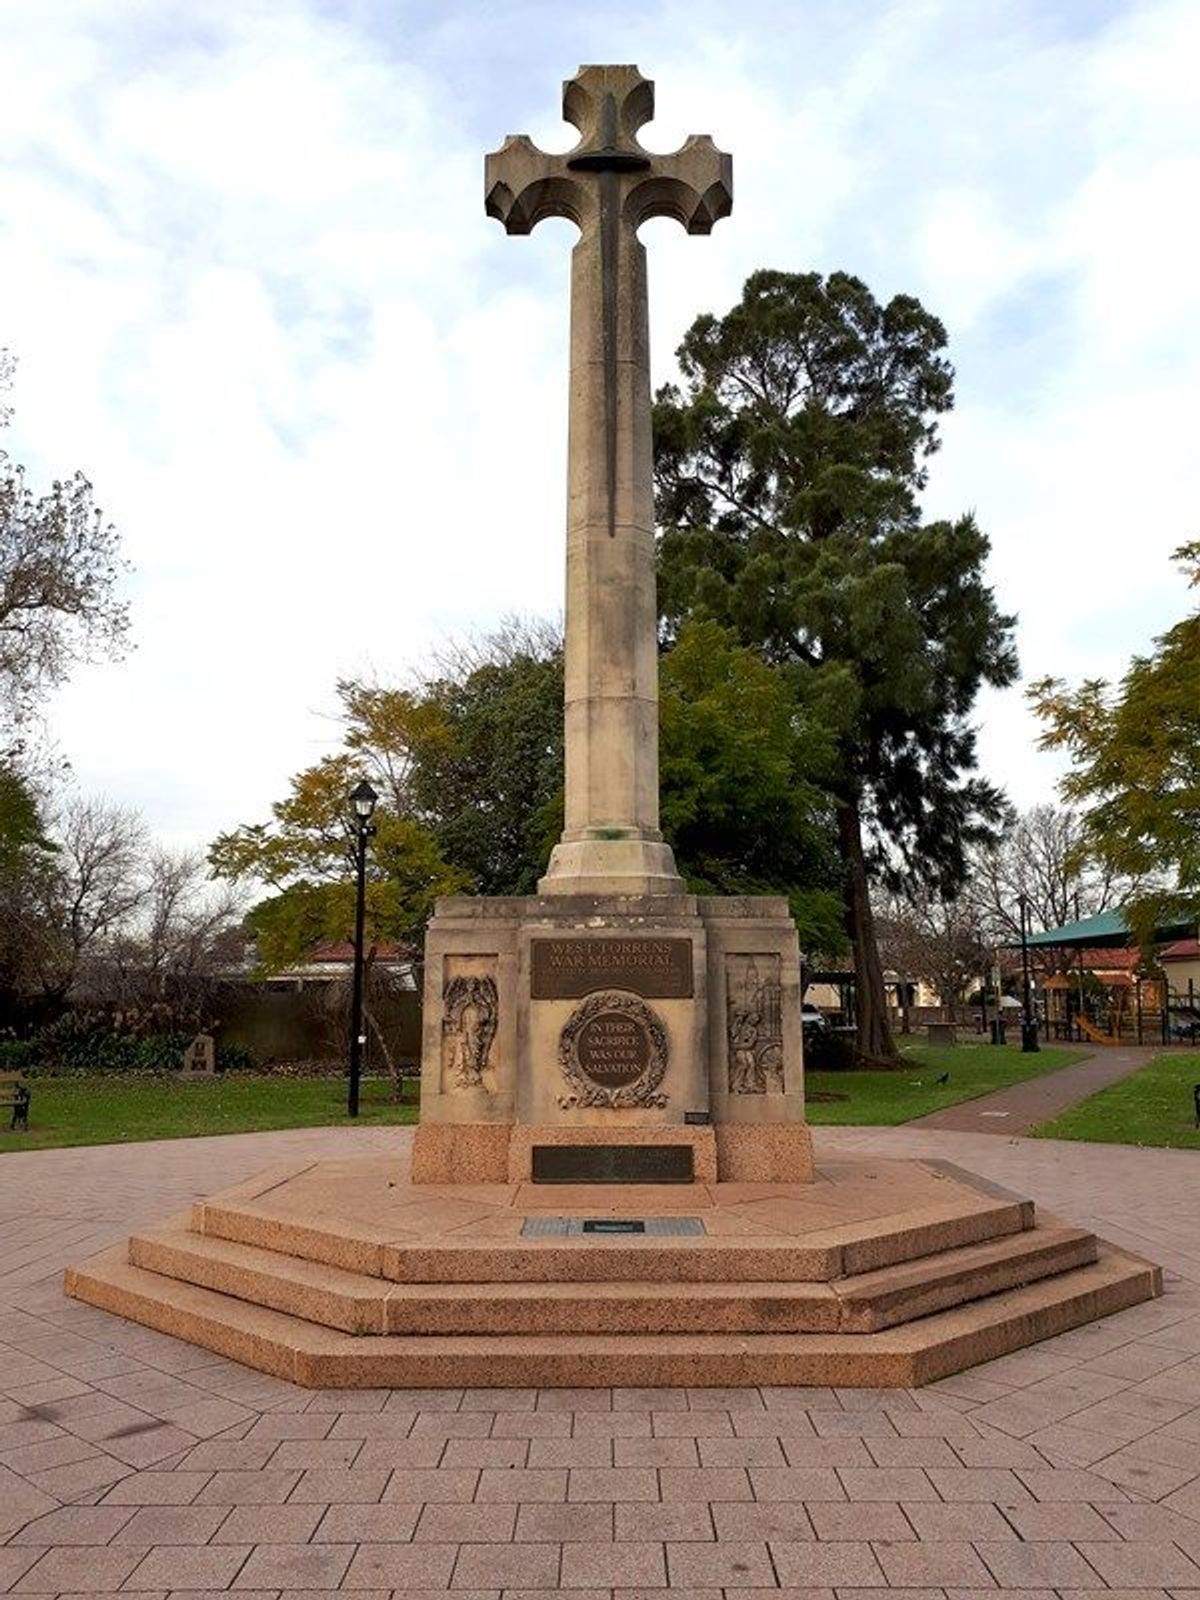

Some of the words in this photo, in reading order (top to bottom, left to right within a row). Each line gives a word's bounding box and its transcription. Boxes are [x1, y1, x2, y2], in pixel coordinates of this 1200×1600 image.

[551, 942, 592, 953] WEST
[600, 942, 673, 954] TORRENS
[551, 955, 586, 967] WAR
[588, 955, 674, 967] MEMORIAL
[590, 1050, 612, 1060] WAS
[585, 1063, 641, 1073] SALVATION
